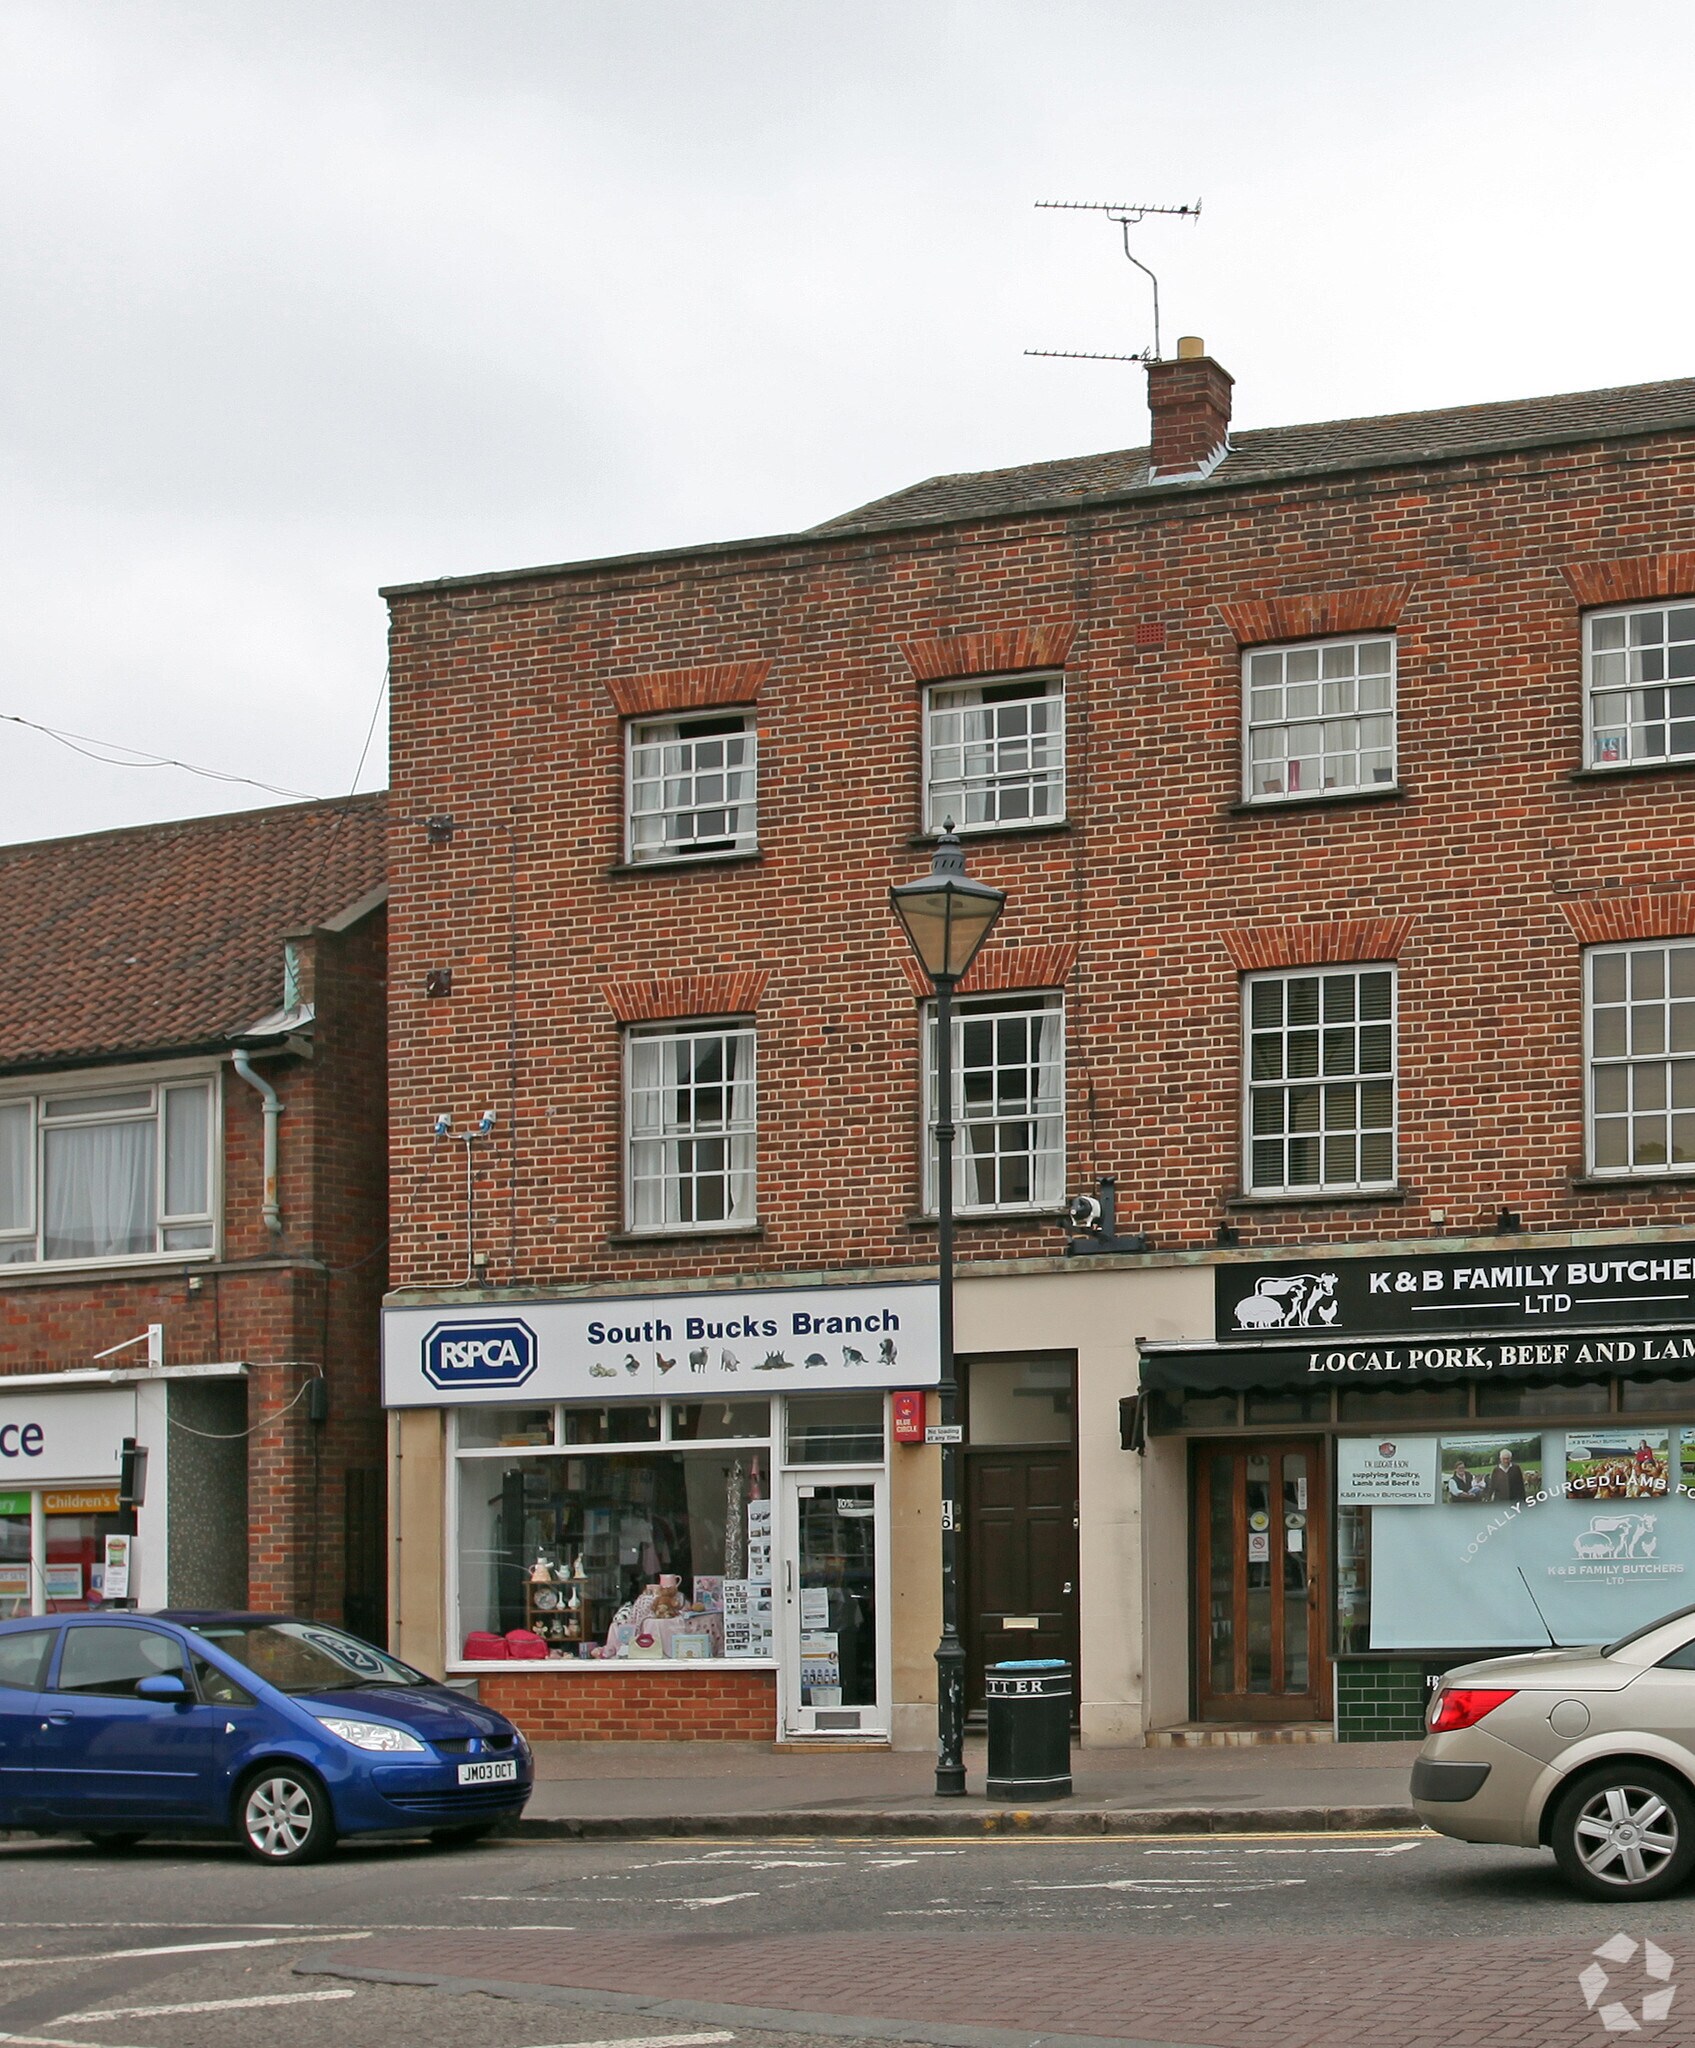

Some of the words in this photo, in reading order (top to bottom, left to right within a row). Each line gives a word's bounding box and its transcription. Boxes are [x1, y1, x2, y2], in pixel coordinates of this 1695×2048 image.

[1453, 1264, 1560, 1290] FAMILY
[1567, 1257, 1695, 1285] BUTCHE
[1524, 1294, 1572, 1314] LTD
[587, 1319, 672, 1345] South
[686, 1315, 778, 1340] Bucks
[792, 1309, 900, 1335] Branch
[441, 1338, 521, 1369] RSPCA
[1308, 1350, 1402, 1372] LOCAL
[1408, 1346, 1493, 1371] PORK,
[1499, 1344, 1570, 1367] BEEF
[1575, 1341, 1637, 1364] AND
[46, 1494, 111, 1509] Children's
[1459, 1502, 1522, 1564] LOCALLY
[1525, 1475, 1611, 1508] SOURCED
[1615, 1474, 1671, 1492] LAMB,
[1579, 1565, 1620, 1575] FAMILY
[1622, 1563, 1685, 1574] BUTCHERS
[1606, 1577, 1625, 1585] LTD
[464, 1765, 493, 1780] JM03
[495, 1763, 512, 1778] OCT
